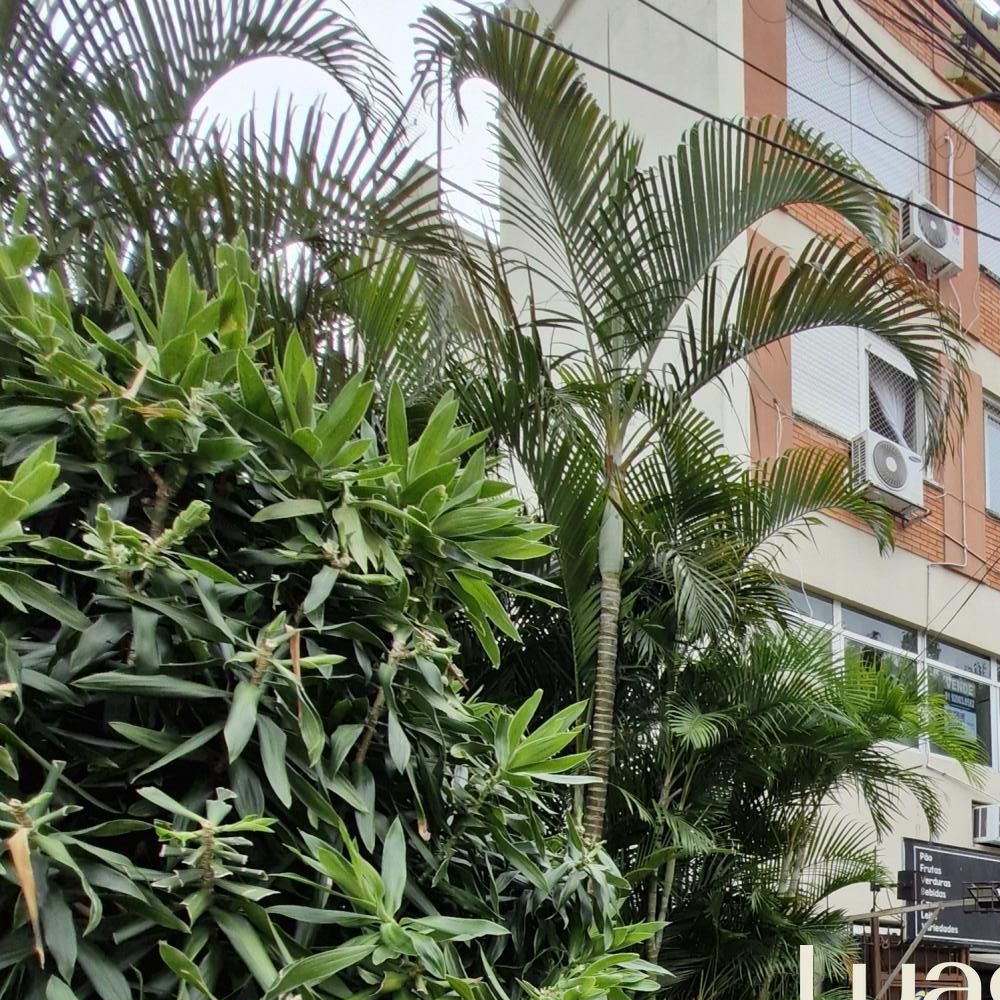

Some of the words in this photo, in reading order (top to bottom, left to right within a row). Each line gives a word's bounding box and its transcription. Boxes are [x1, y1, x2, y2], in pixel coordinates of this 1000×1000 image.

[943, 675, 976, 699] VENDE
[920, 852, 933, 862] Pão
[920, 864, 942, 875] Frutas
[921, 876, 951, 888] Verduras
[921, 887, 946, 898] Bebidas
